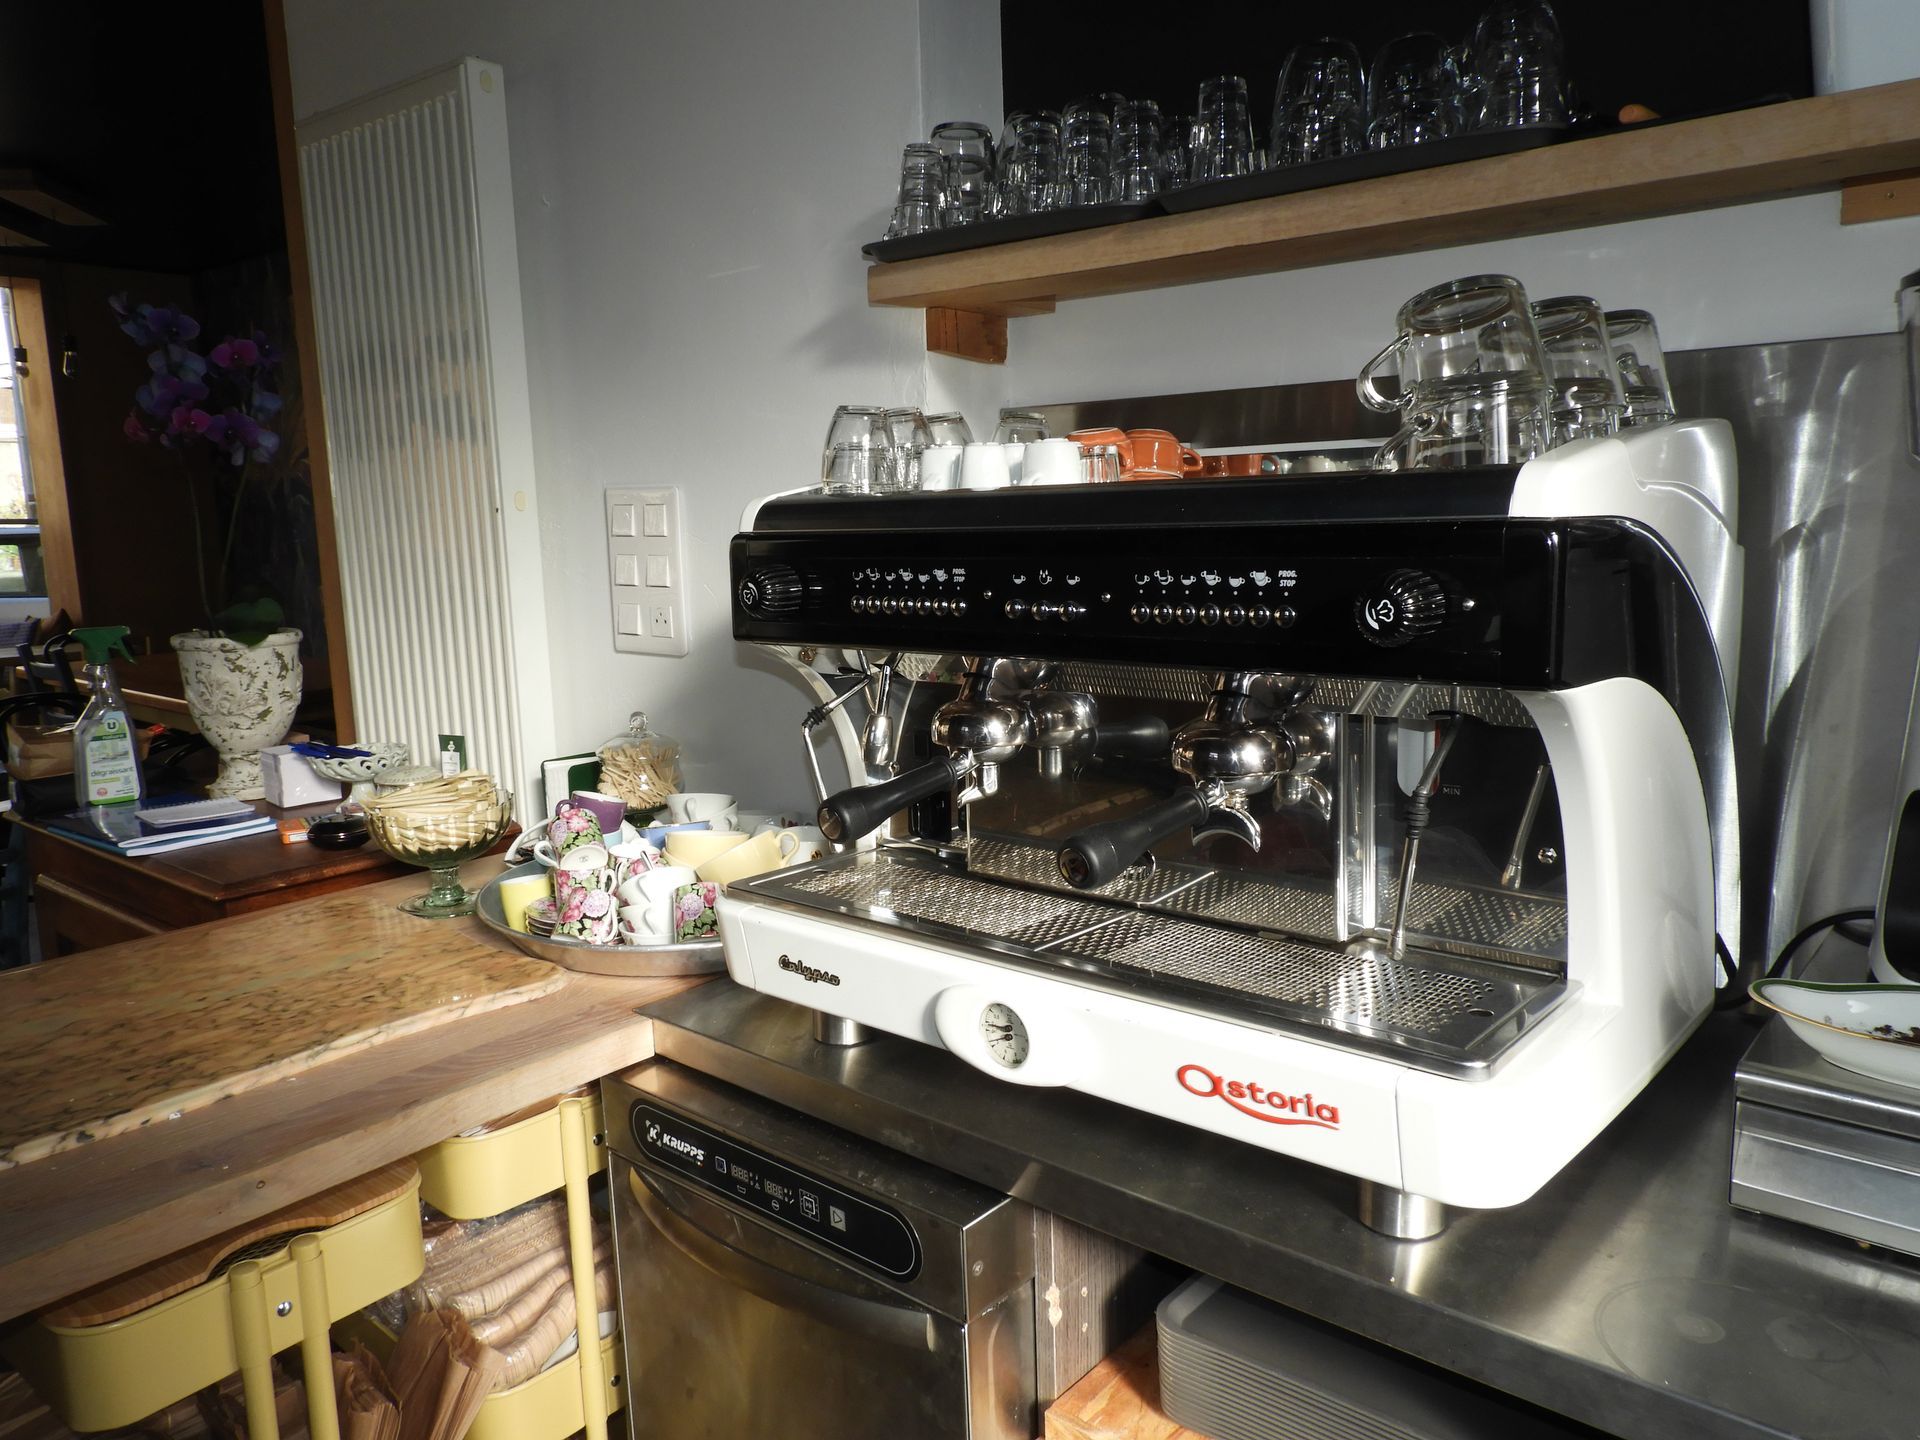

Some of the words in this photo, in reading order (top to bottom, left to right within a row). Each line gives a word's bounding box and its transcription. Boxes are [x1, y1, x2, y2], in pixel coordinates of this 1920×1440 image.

[1279, 579, 1296, 587] STOP
[1442, 786, 1460, 796] MIN
[662, 1132, 705, 1162] KRUPPS
